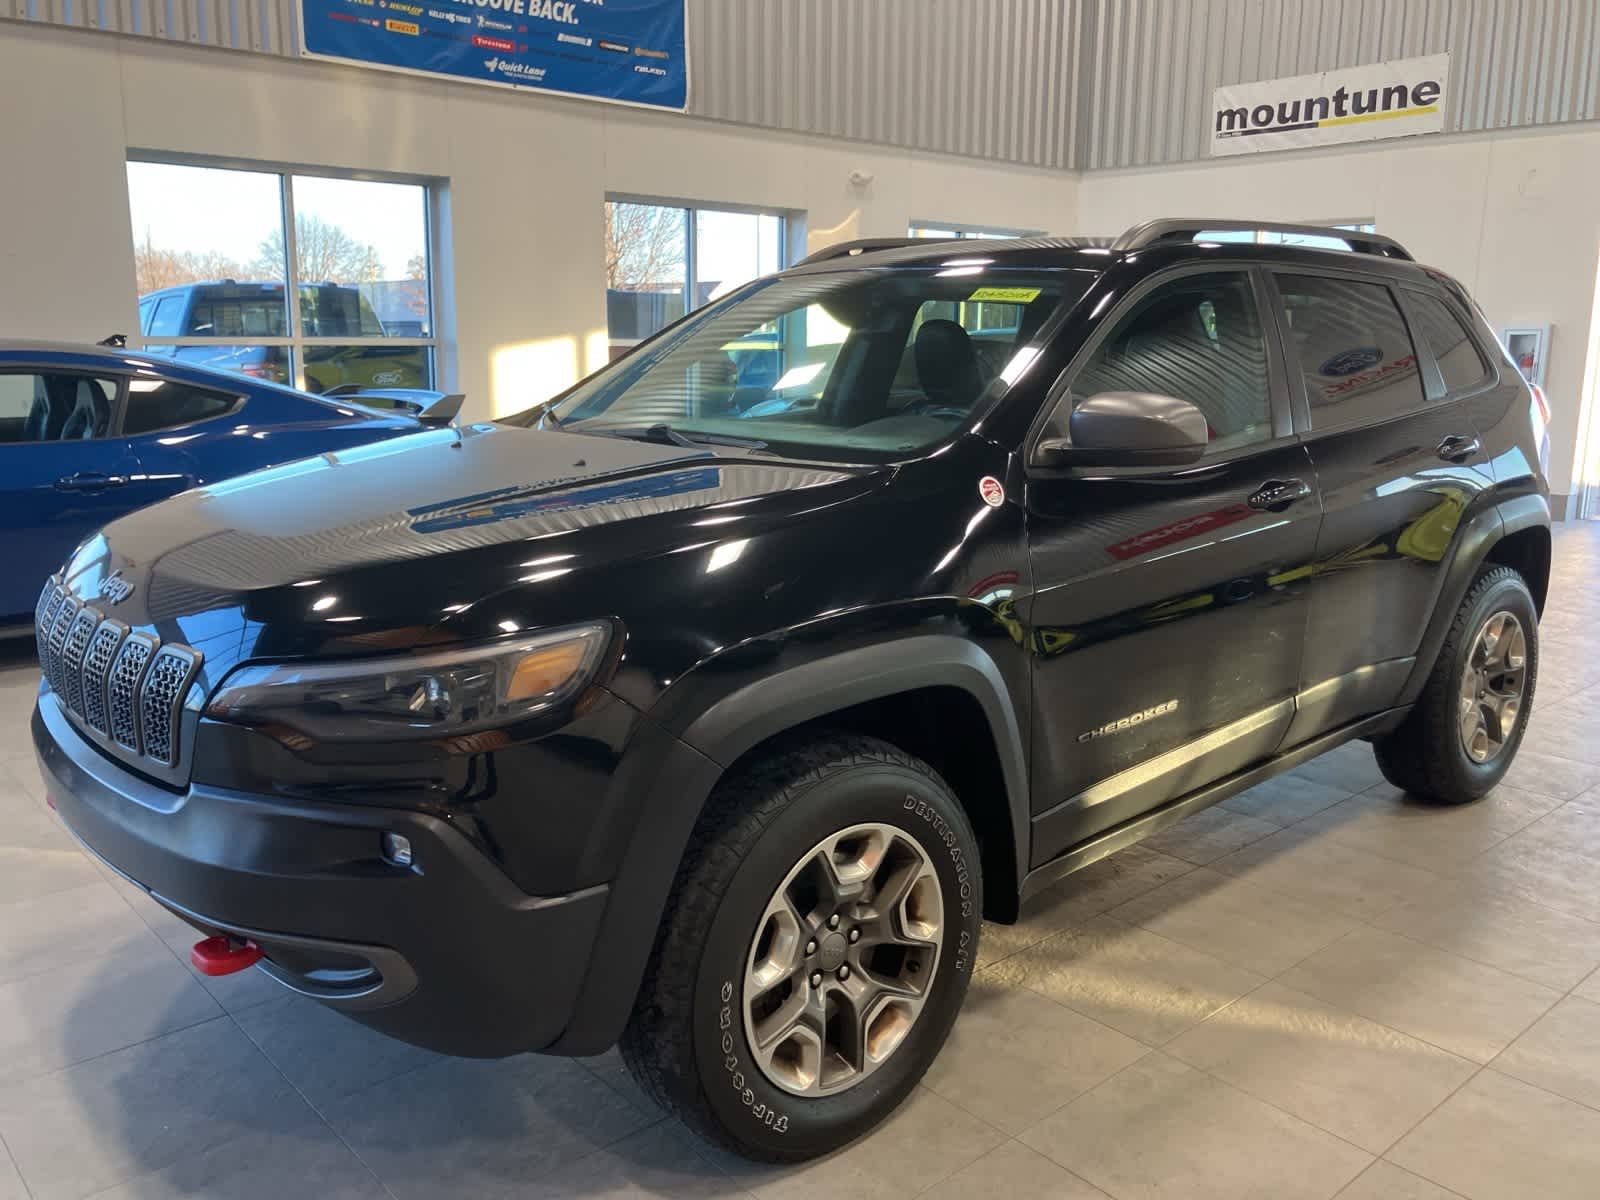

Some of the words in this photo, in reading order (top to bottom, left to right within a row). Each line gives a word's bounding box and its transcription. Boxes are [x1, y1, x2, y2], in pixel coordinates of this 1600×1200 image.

[528, 0, 579, 25] BACK.
[498, 60, 522, 73] Quick
[523, 64, 546, 77] Lane
[1215, 80, 1441, 132] mountune
[97, 568, 135, 606] Jeep
[1077, 699, 1179, 743] CHEROKEE
[903, 794, 972, 918] DESTINATION
